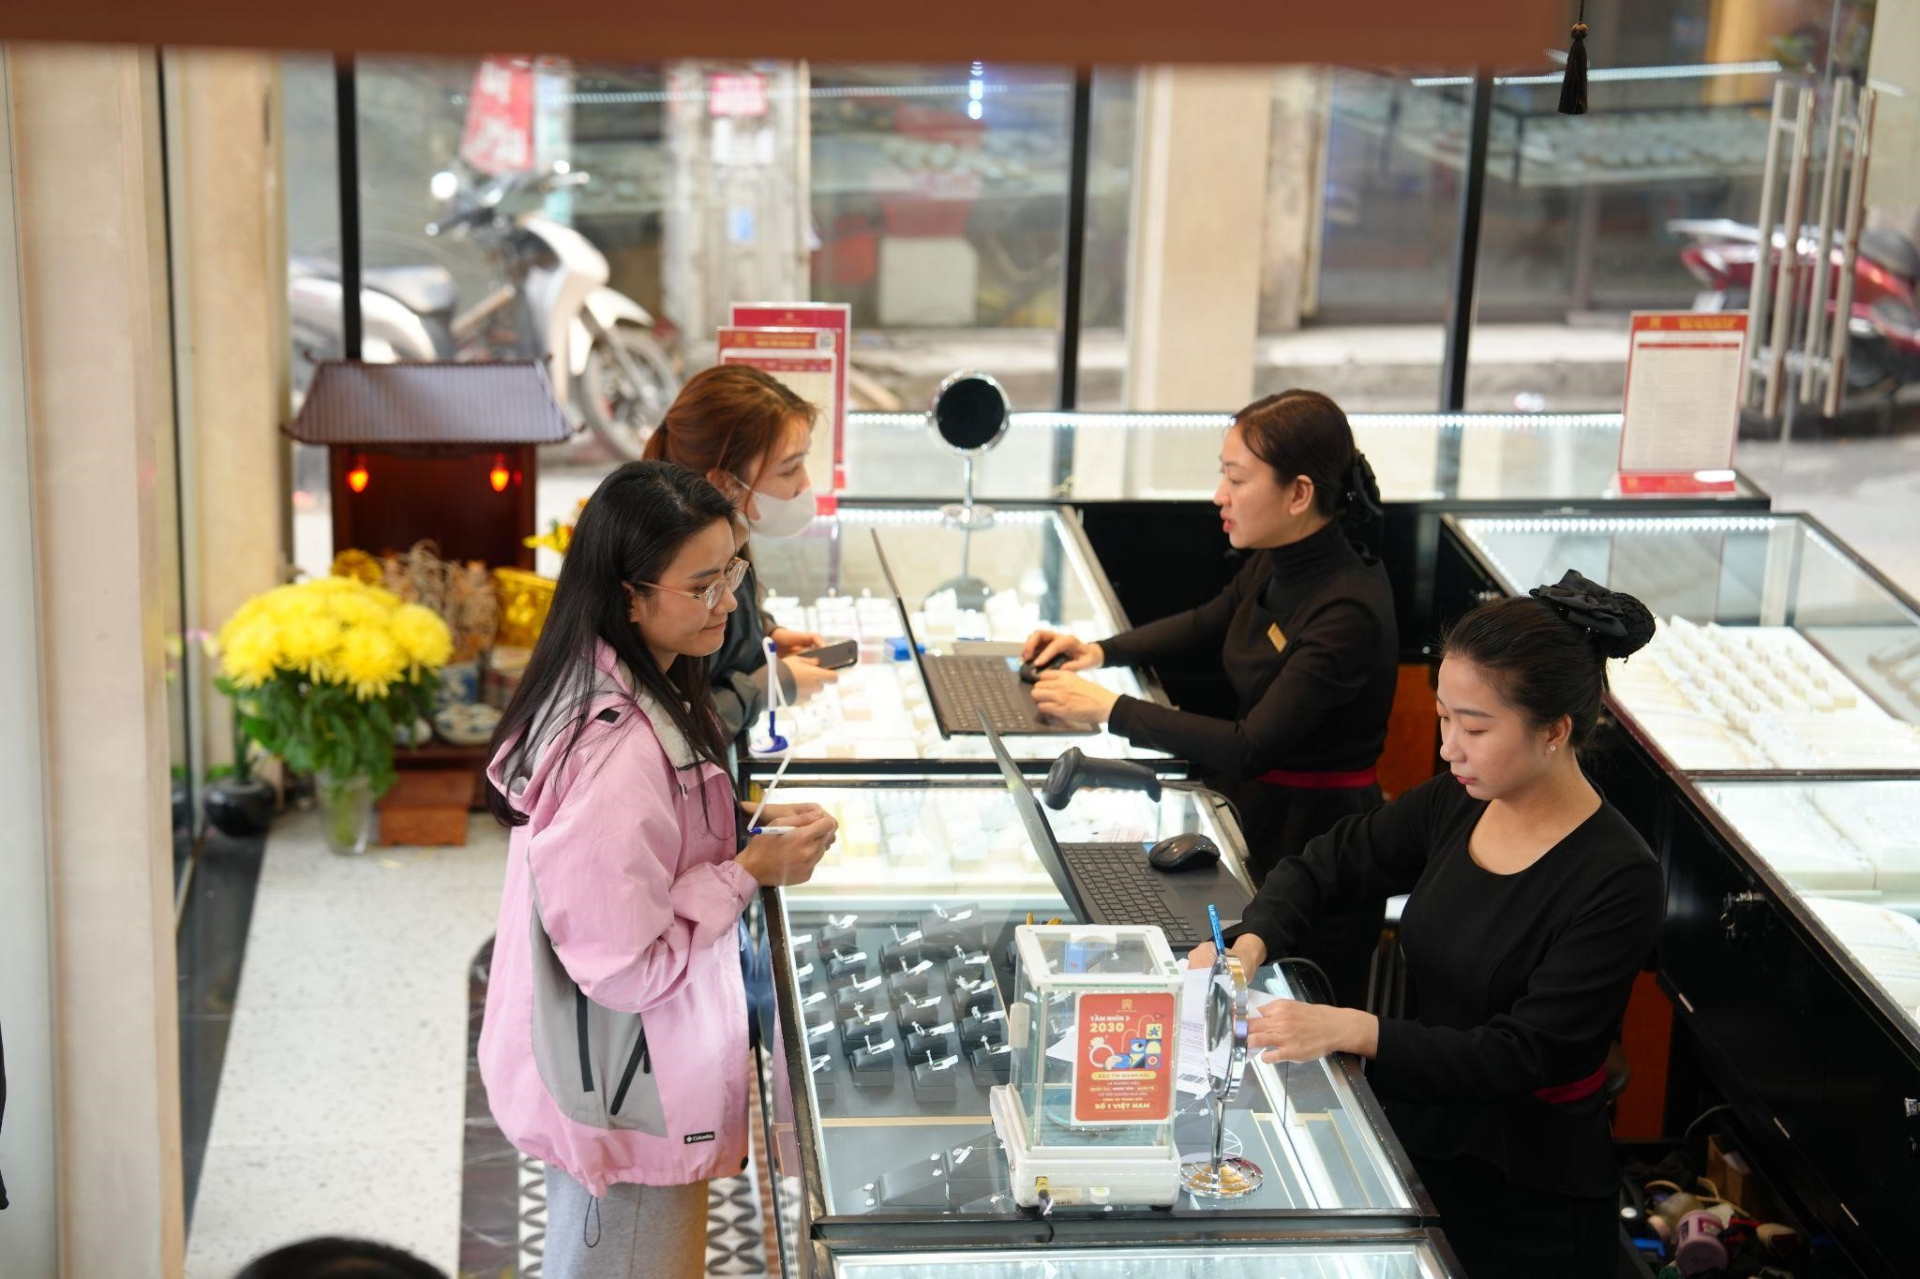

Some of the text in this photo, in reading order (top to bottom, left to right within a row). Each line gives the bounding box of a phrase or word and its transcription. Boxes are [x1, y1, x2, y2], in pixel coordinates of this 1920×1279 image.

[1090, 1022, 1125, 1033] 2030
[1094, 1101, 1106, 1110] SỐ
[1112, 1101, 1131, 1110] VIỆT
[692, 1133, 713, 1141] Columbia
